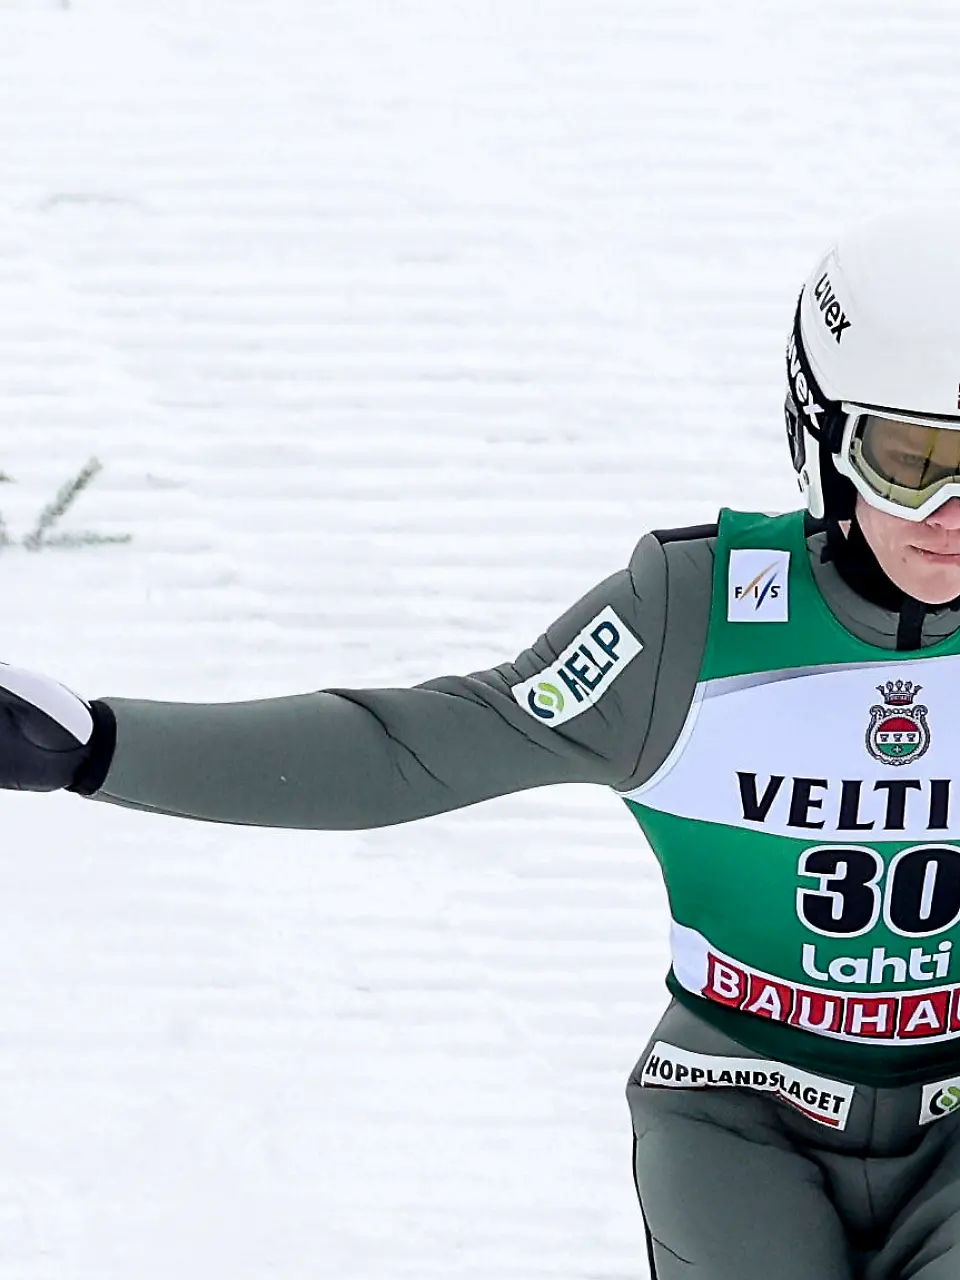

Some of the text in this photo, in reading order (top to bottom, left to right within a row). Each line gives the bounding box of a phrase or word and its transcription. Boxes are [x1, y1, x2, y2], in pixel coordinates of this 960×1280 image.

[815, 272, 851, 344] uvex
[557, 620, 620, 703] HELP
[802, 940, 952, 985] Lahti
[645, 1055, 845, 1114] HOPPLANDSLAGET
